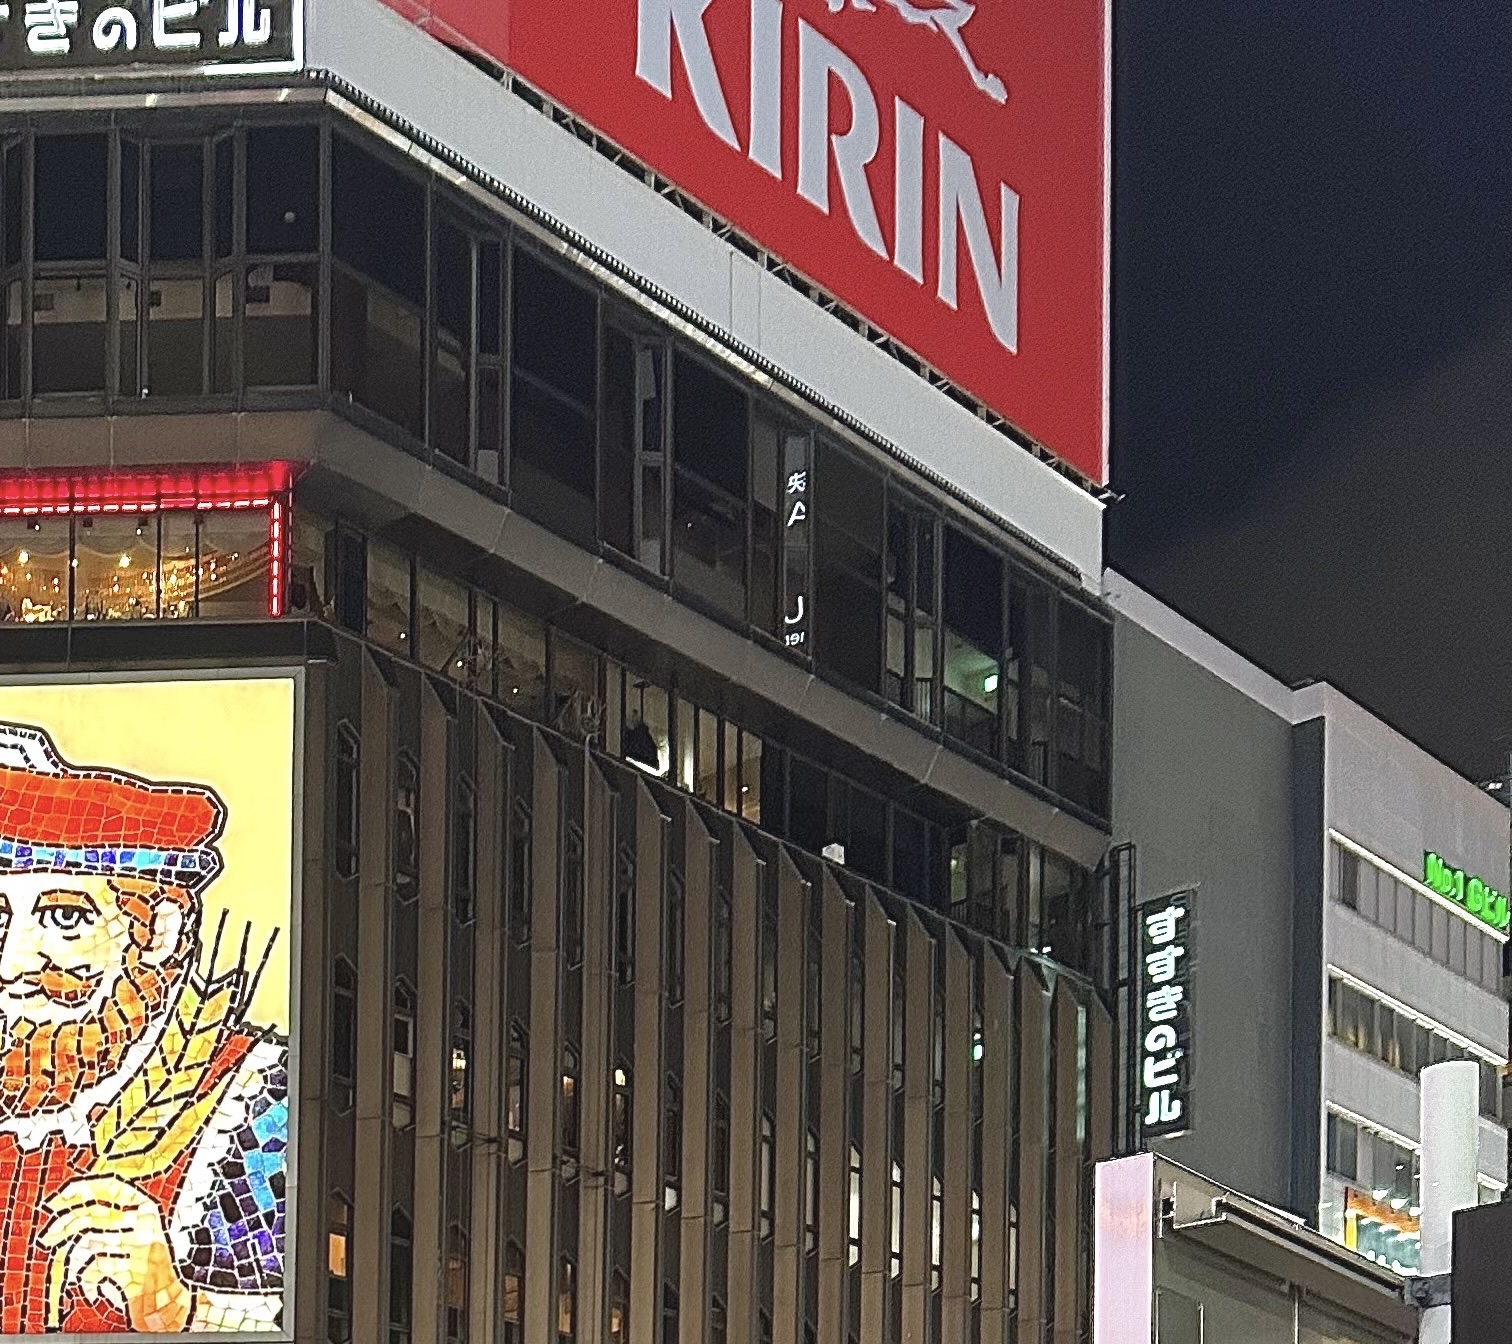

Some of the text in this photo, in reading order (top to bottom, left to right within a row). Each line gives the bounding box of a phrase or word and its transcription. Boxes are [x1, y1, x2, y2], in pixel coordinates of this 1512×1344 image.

[1143, 904, 1186, 1126] すすきのビル
